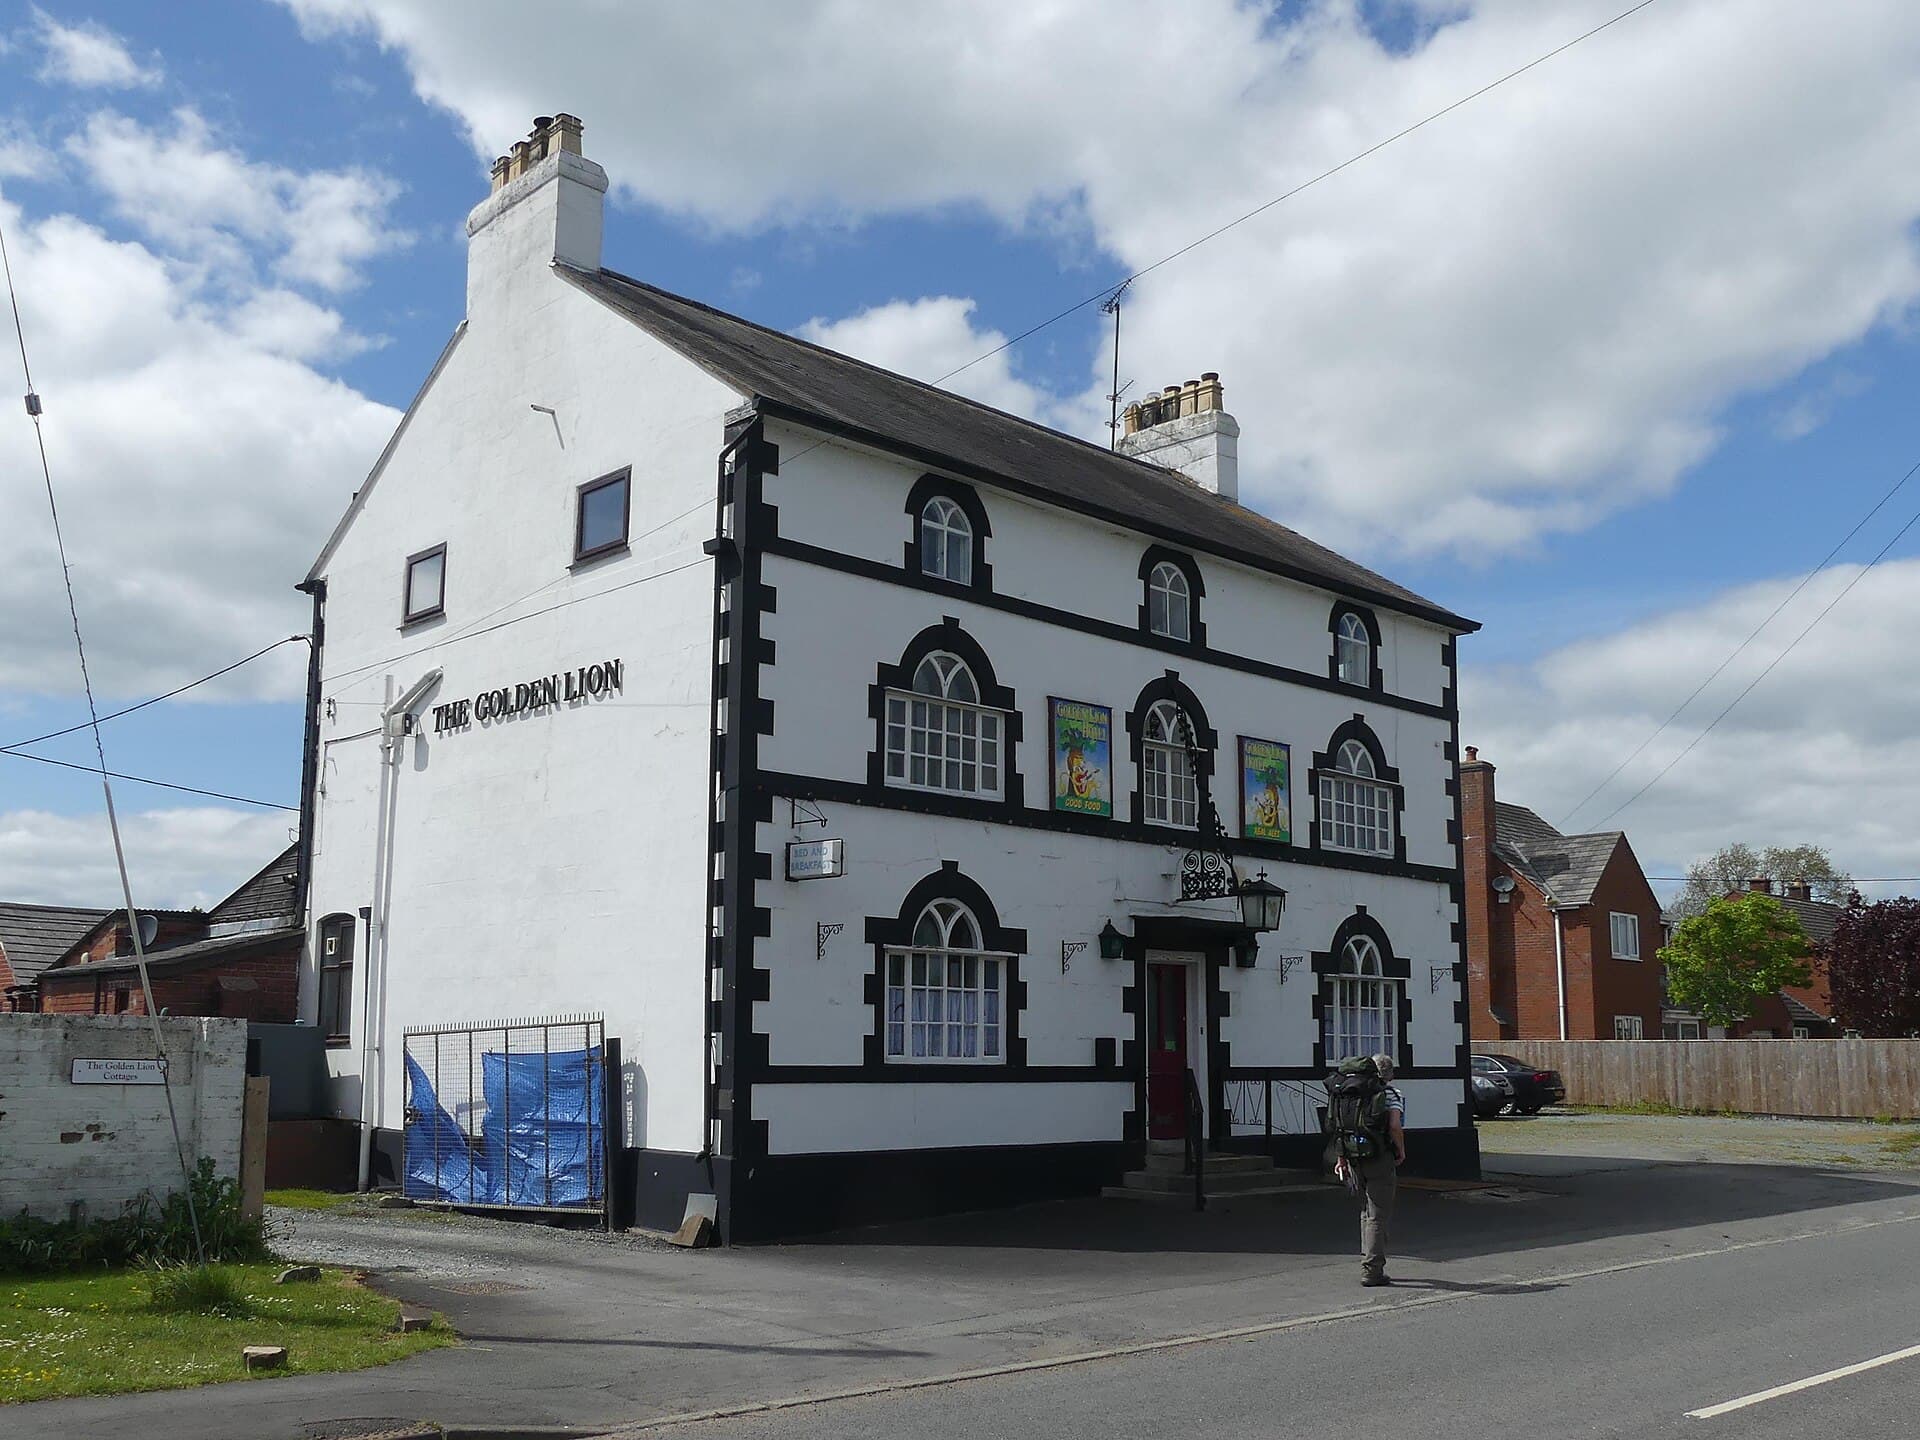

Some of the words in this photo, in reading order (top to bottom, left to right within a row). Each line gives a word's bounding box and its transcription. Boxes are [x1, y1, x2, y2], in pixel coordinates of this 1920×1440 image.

[433, 698, 471, 733] THE
[474, 674, 559, 721] GOLDEN
[563, 658, 620, 702] LION
[1084, 801, 1101, 811] FOOD
[793, 847, 808, 858] BED
[811, 846, 828, 857] AND
[791, 859, 831, 872] BREAKFAST
[87, 1061, 104, 1070] The
[105, 1061, 135, 1070] Golden
[137, 1062, 155, 1071] Lion
[103, 1072, 138, 1081] Cottages
